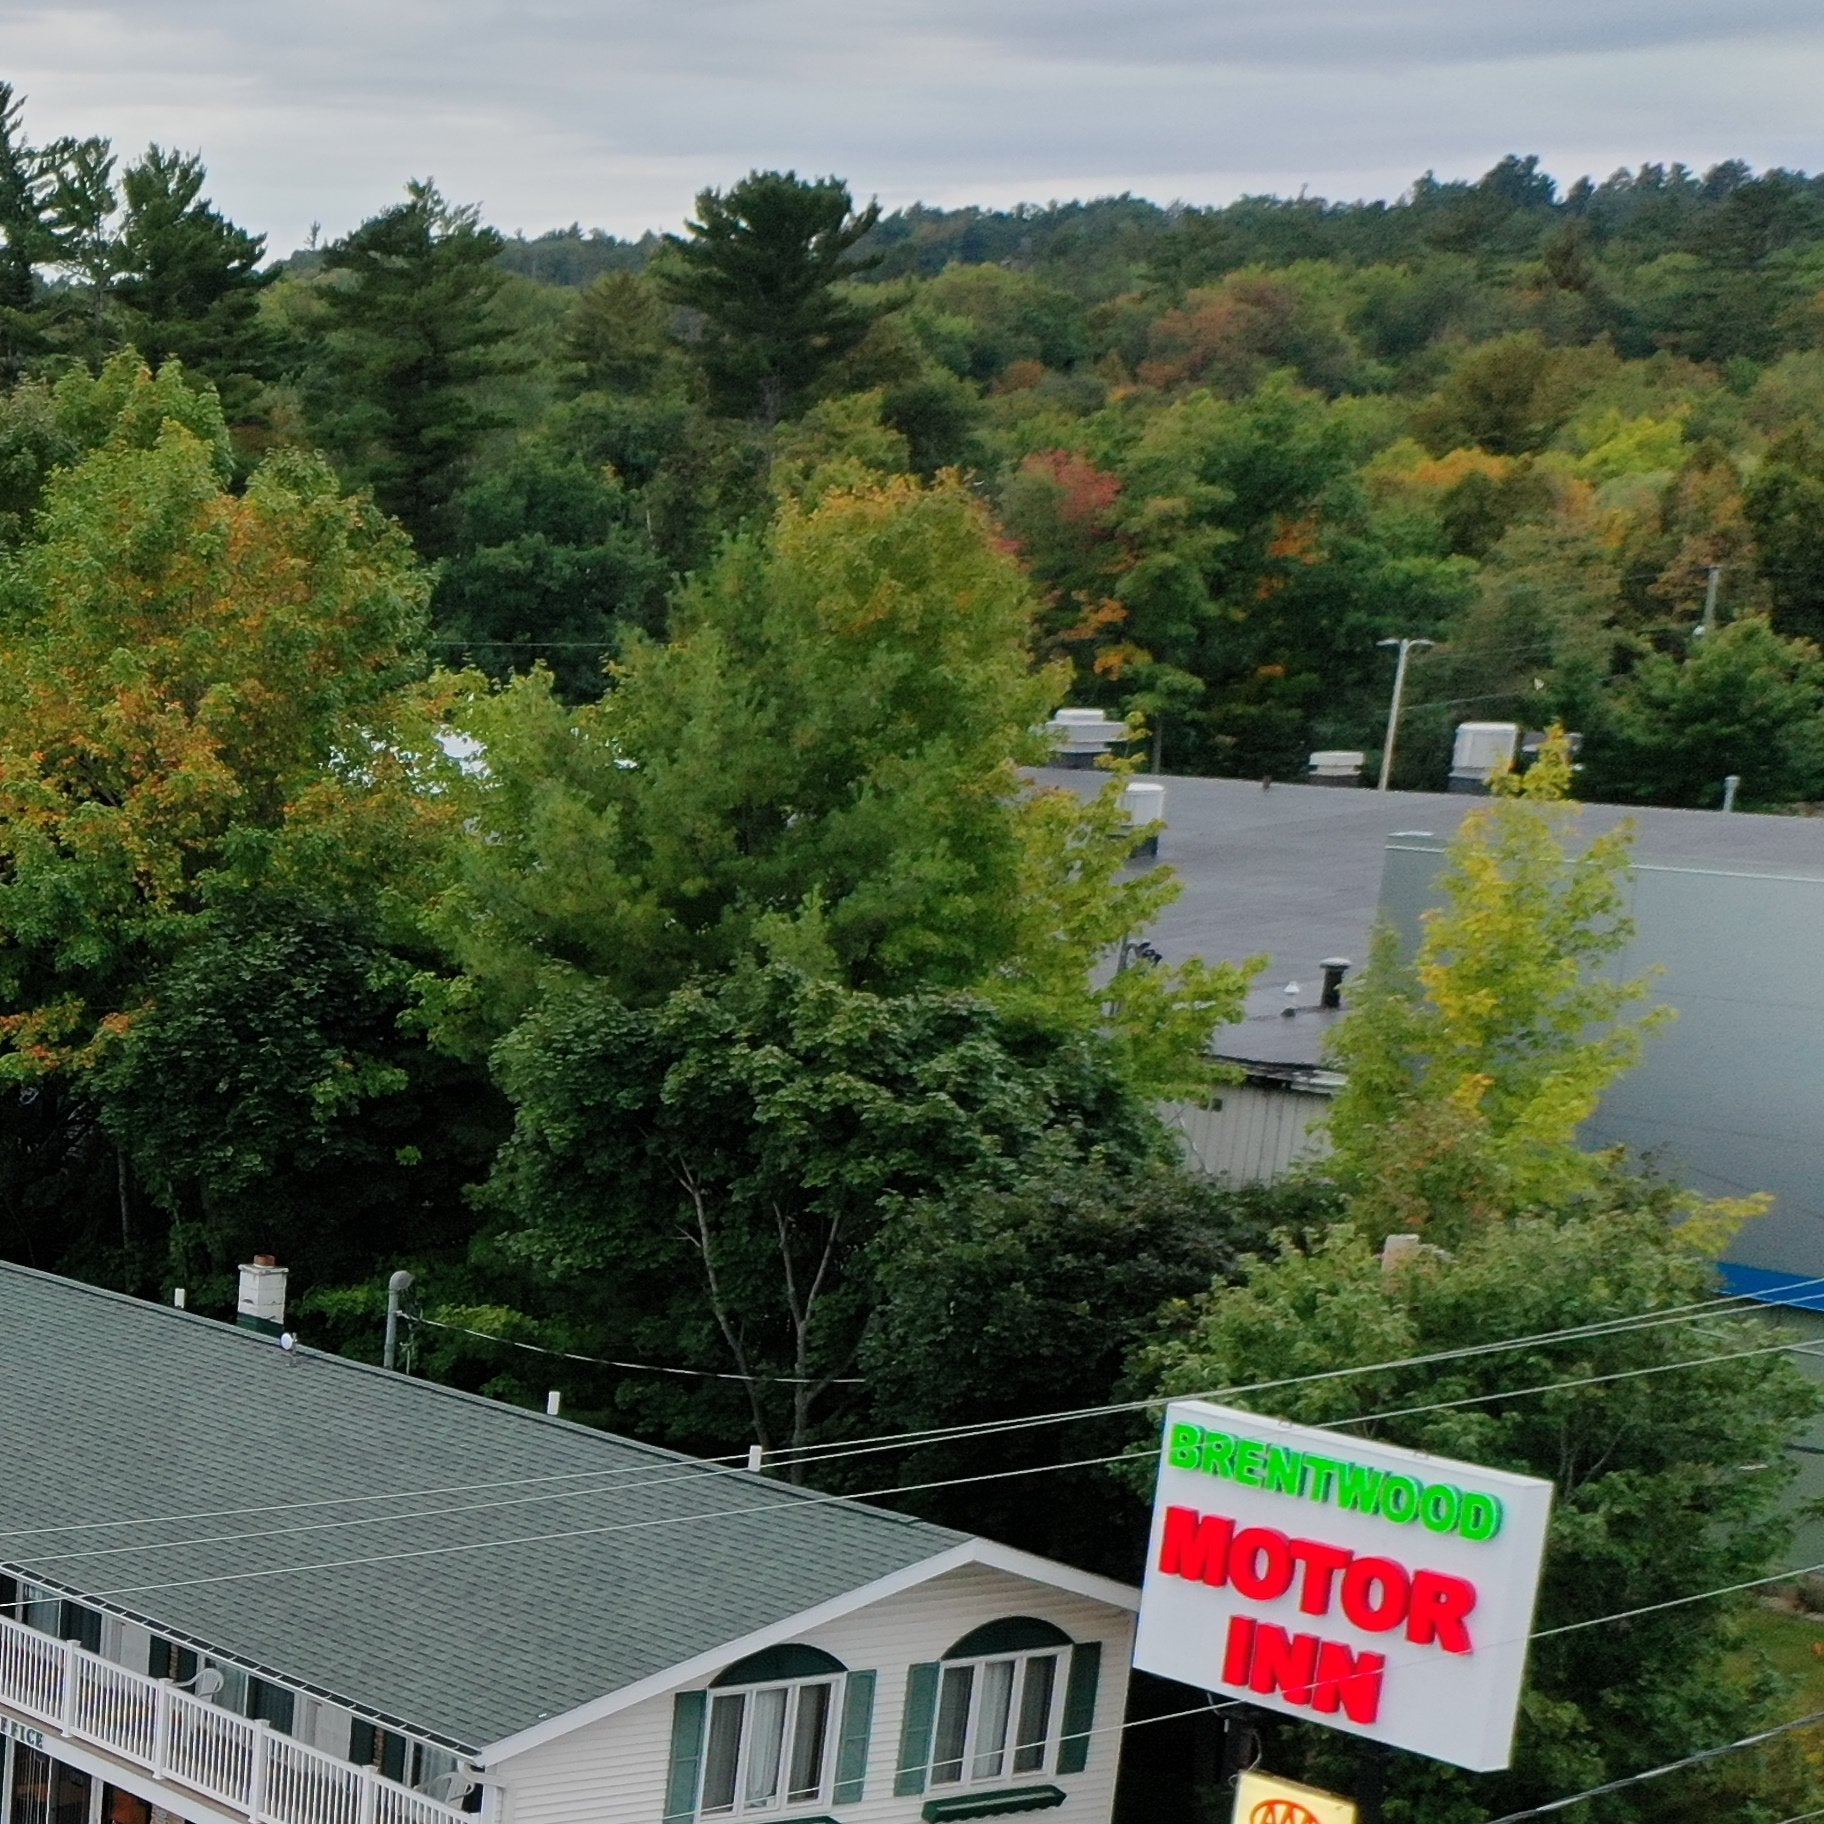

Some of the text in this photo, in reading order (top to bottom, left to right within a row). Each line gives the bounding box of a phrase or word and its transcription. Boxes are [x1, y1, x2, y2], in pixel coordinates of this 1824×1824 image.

[1168, 1420, 1504, 1542] BRENTWOOD
[1159, 1505, 1477, 1655] MOTOR
[1221, 1613, 1386, 1724] INN
